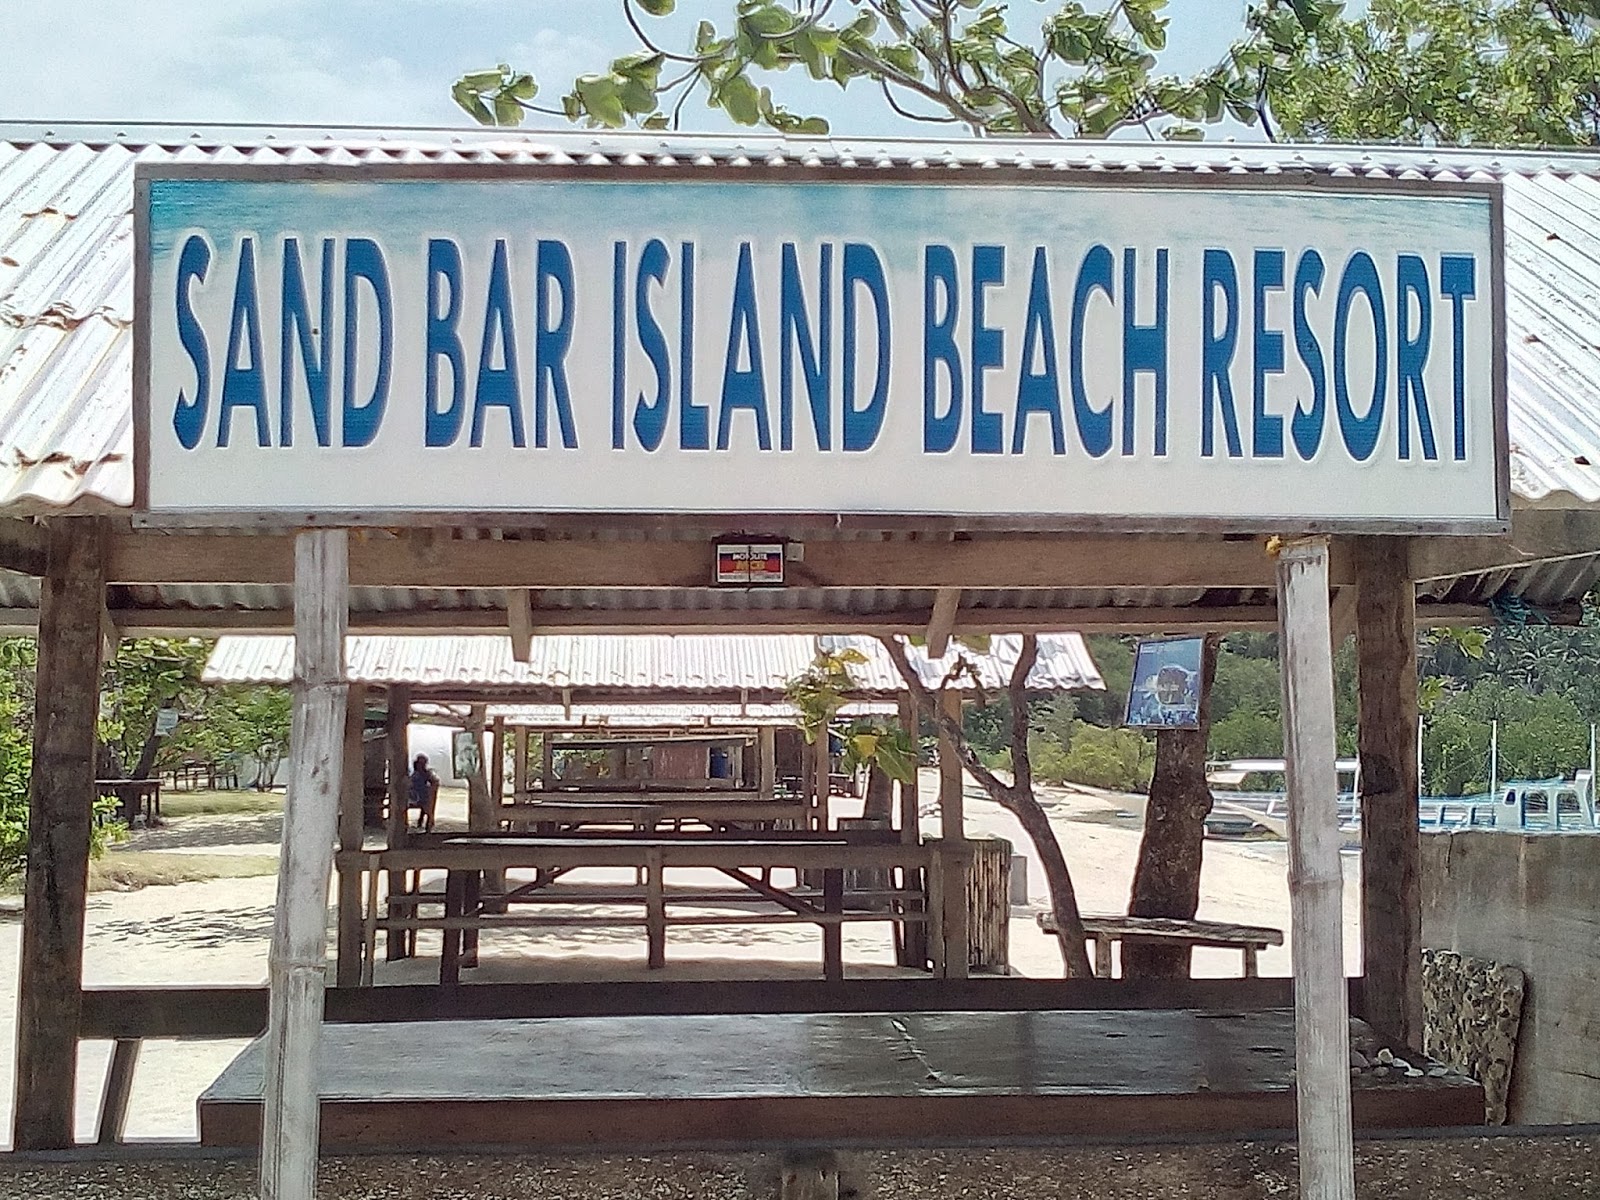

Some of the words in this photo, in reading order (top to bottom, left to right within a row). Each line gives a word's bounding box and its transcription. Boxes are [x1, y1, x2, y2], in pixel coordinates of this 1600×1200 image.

[172, 234, 392, 449] SAND
[424, 238, 577, 448] BAR
[612, 238, 891, 450] ISLAND
[923, 244, 1169, 457] BEACH
[1201, 248, 1476, 461] RESORT
